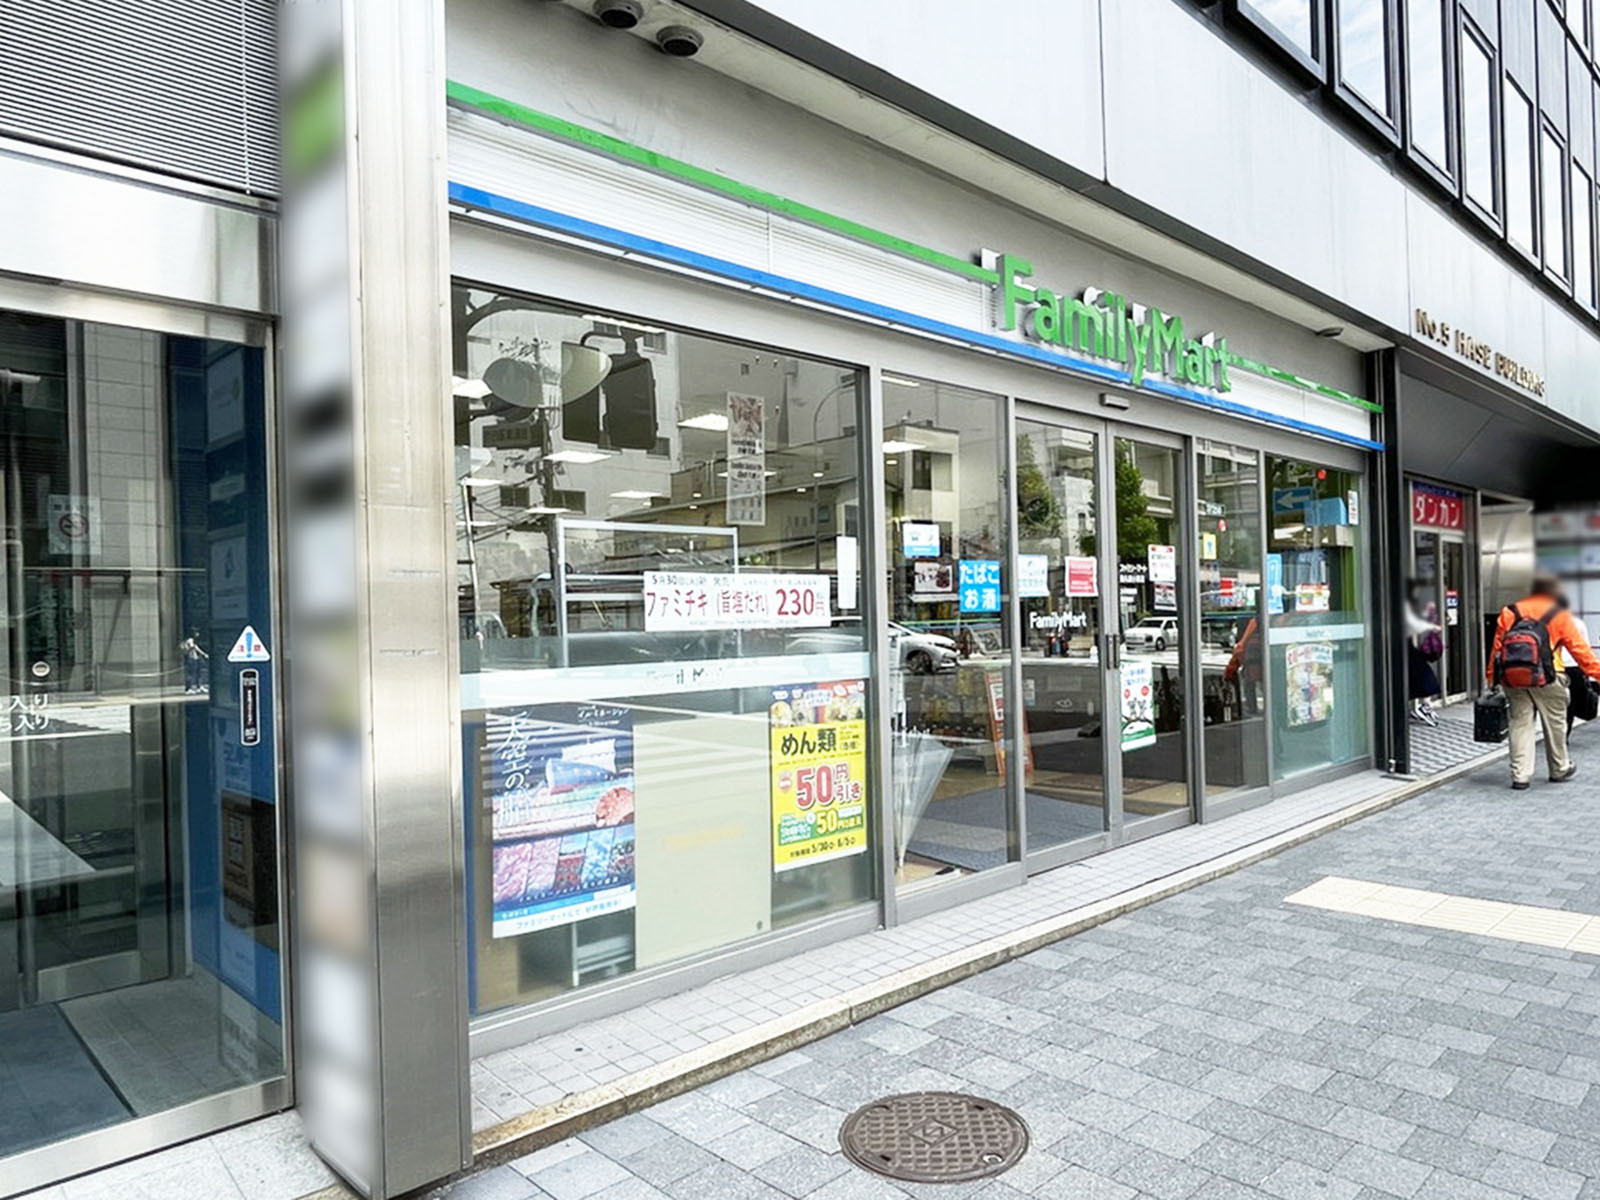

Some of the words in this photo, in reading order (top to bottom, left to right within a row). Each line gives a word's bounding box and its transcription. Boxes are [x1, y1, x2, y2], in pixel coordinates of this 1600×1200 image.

[998, 253, 1232, 392] FamilyMart
[1415, 308, 1450, 347] No.5
[1455, 329, 1492, 370] HASE
[1415, 494, 1460, 528] ダンカン
[960, 563, 1000, 584] たばこ
[646, 588, 709, 618] ファミチキ
[964, 588, 996, 610] お酒
[1028, 611, 1088, 632] FamilyMart
[780, 727, 838, 757] めん類
